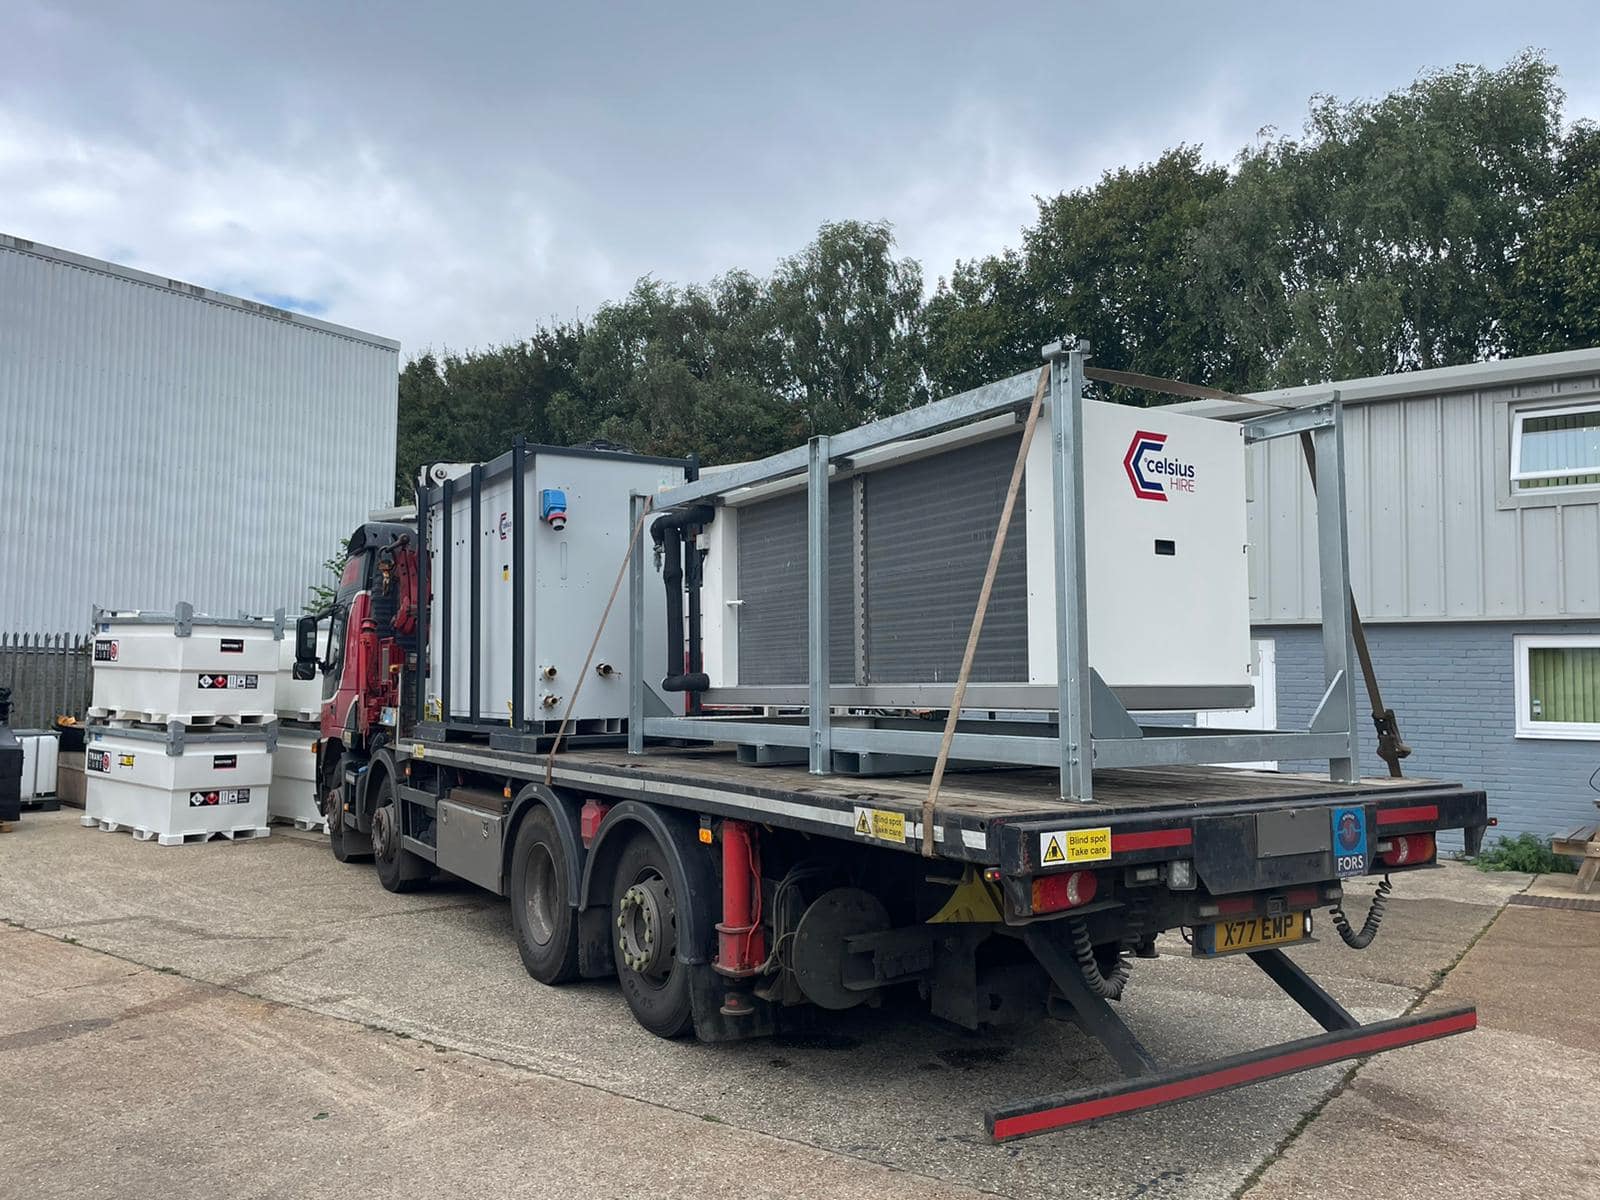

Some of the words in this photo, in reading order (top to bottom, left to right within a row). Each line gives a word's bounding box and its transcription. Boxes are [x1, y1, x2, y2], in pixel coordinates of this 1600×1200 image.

[1170, 477, 1195, 493] HIRE
[1069, 835, 1089, 845] Blind
[1090, 834, 1107, 845] spot
[1070, 847, 1089, 857] Take
[1090, 846, 1107, 855] care
[1337, 855, 1364, 871] FORS
[1224, 920, 1257, 947] X77
[1261, 914, 1294, 941] EMP
